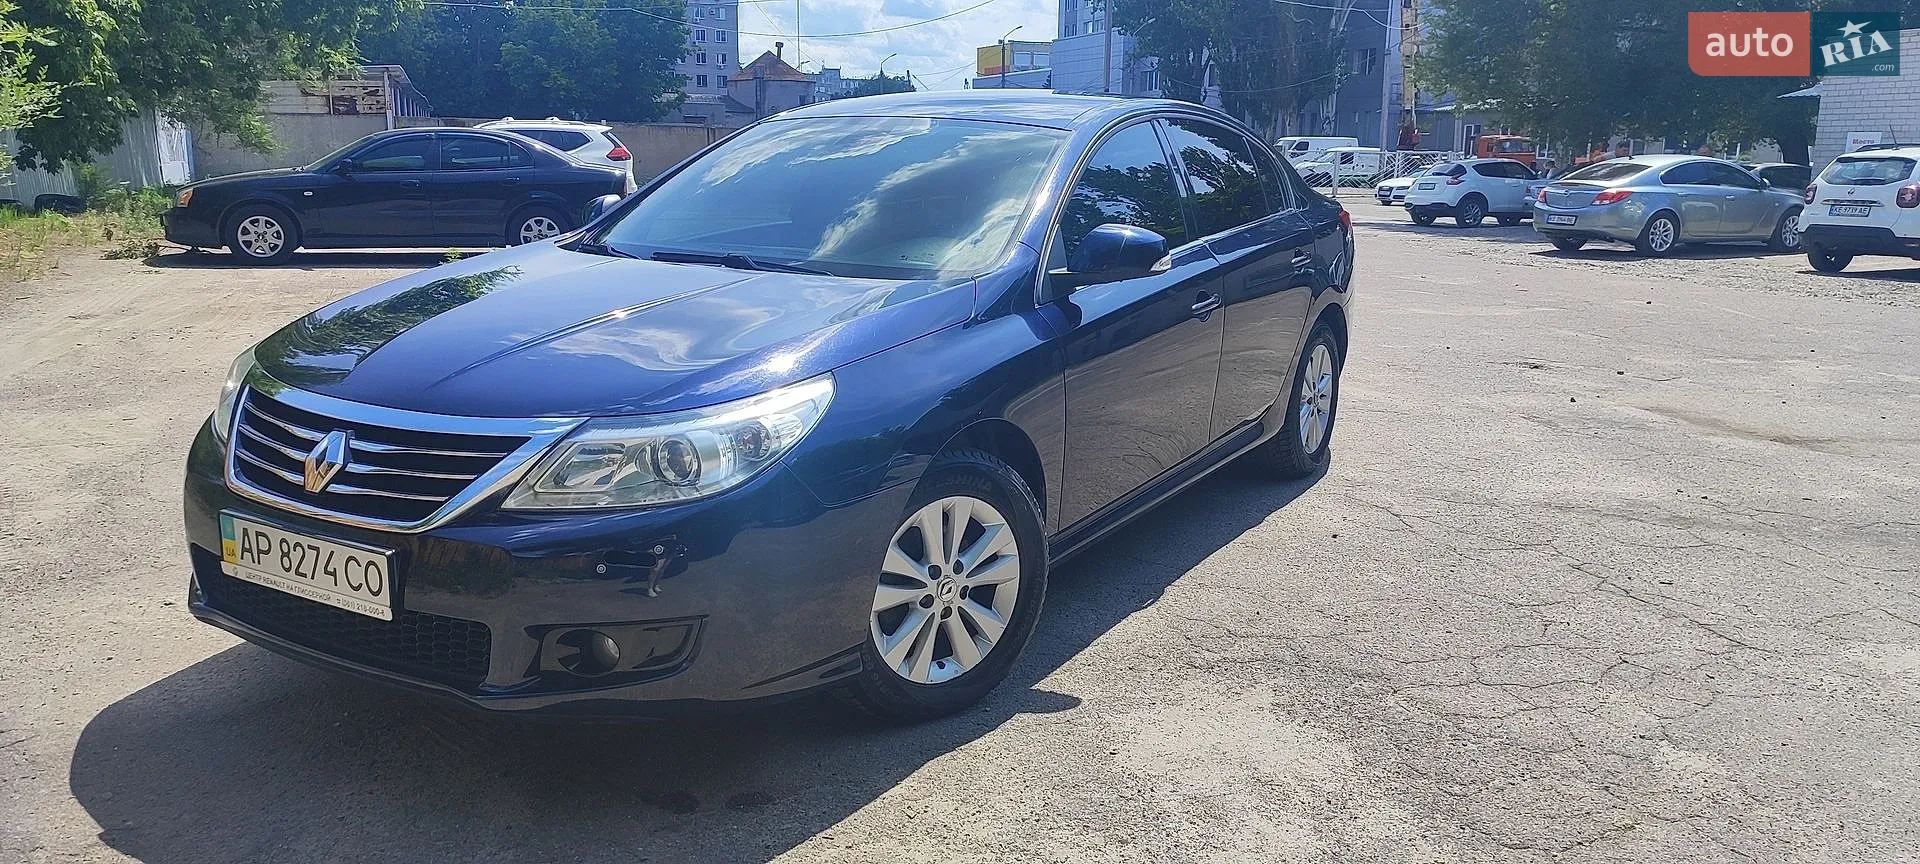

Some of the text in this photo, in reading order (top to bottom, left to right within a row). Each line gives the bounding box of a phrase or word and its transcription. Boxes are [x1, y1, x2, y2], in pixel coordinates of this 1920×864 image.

[226, 547, 237, 558] UA
[240, 527, 384, 597] AP 8274 CO
